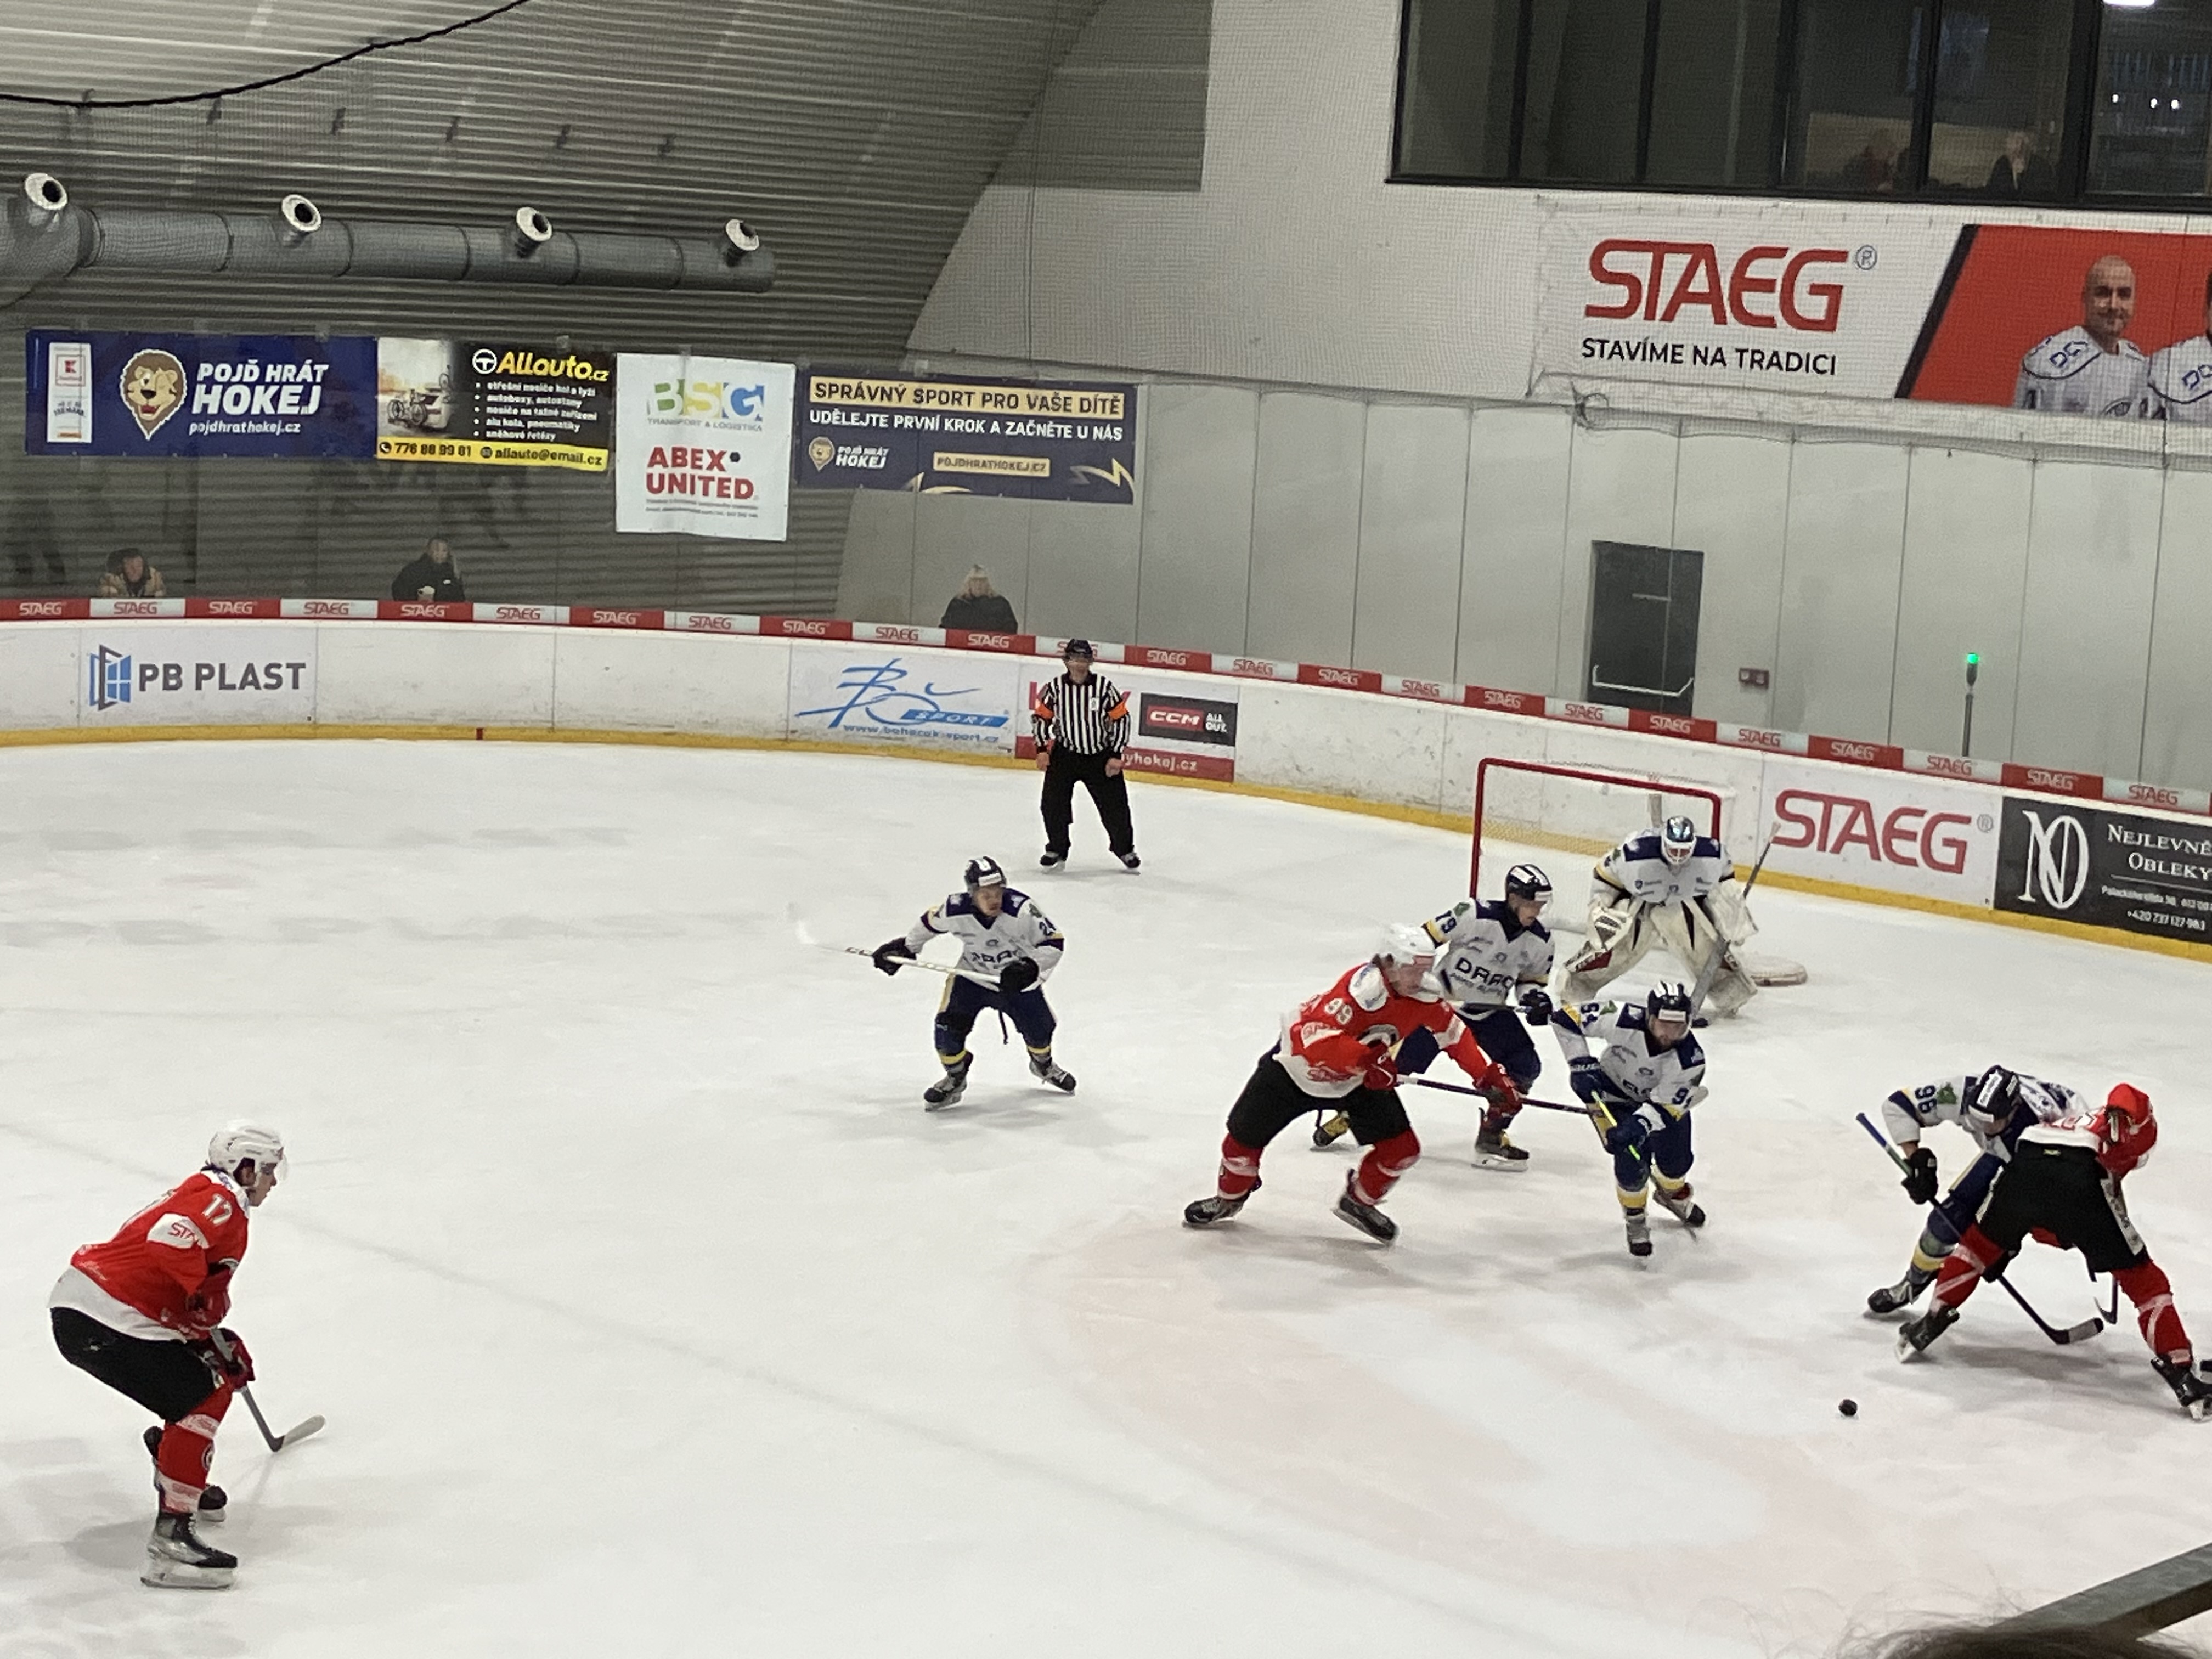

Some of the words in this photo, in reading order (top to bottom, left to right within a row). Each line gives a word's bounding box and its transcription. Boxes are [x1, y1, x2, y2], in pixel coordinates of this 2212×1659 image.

[1585, 238, 1848, 332] STAEG
[1582, 336, 1684, 365] STAVÍME
[1693, 345, 1726, 367] NA
[1736, 348, 1836, 375] TRADICI
[197, 359, 260, 382] POJĎ
[265, 359, 329, 382] HRÁT
[496, 352, 610, 382] Allauto.cz
[192, 384, 321, 415] HOKEJ
[646, 379, 765, 421] BSG
[815, 381, 907, 403] SPRÁVNÝ
[913, 388, 975, 407] SPORT
[981, 392, 1019, 409] PRO
[1026, 391, 1073, 412] VAŠE
[1080, 394, 1121, 414] DÍTĚ
[189, 420, 301, 436] pojdhrathokej.cz
[810, 408, 889, 427] UDĚLEJTE
[893, 414, 941, 431] PRVNÍ
[944, 417, 986, 433] KROK
[989, 421, 1001, 434] A
[1005, 420, 1073, 438] ZAČNĚTE
[1077, 425, 1088, 438] U
[1093, 424, 1123, 441] NÁS
[495, 448, 602, 465] allauto@email.cz
[647, 446, 727, 472] ABEX
[836, 454, 887, 469] HOKEJ
[646, 472, 754, 500] UNITED
[19, 602, 62, 615] STAEG
[114, 602, 157, 615] STAEG
[209, 602, 253, 614] STAEG
[304, 601, 349, 615] STAEG
[401, 605, 445, 618] STAEG
[496, 607, 540, 620] STAEG
[592, 611, 637, 625] STAEG
[689, 616, 732, 630] STAEG
[783, 621, 827, 635] STAEG
[876, 627, 918, 641] STAEG
[968, 634, 1009, 648] STAEG
[1147, 650, 1186, 665] STAEG
[1233, 659, 1274, 676] STAEG
[139, 663, 183, 692] PB
[195, 663, 306, 691] PLAST
[1318, 668, 1359, 685] STAEG
[1402, 679, 1440, 696] STAEG
[1485, 691, 1522, 708] STAEG
[1150, 711, 1200, 725] CCM
[1566, 703, 1604, 721] STAEG
[1650, 715, 1691, 733] STAEG
[1739, 729, 1781, 747] STAEG
[1831, 742, 1874, 761] STAEG
[1928, 755, 1972, 775] STAEG
[2028, 769, 2074, 790] STAEG
[2129, 785, 2178, 804] STAEG
[1771, 789, 1972, 874] STAEG
